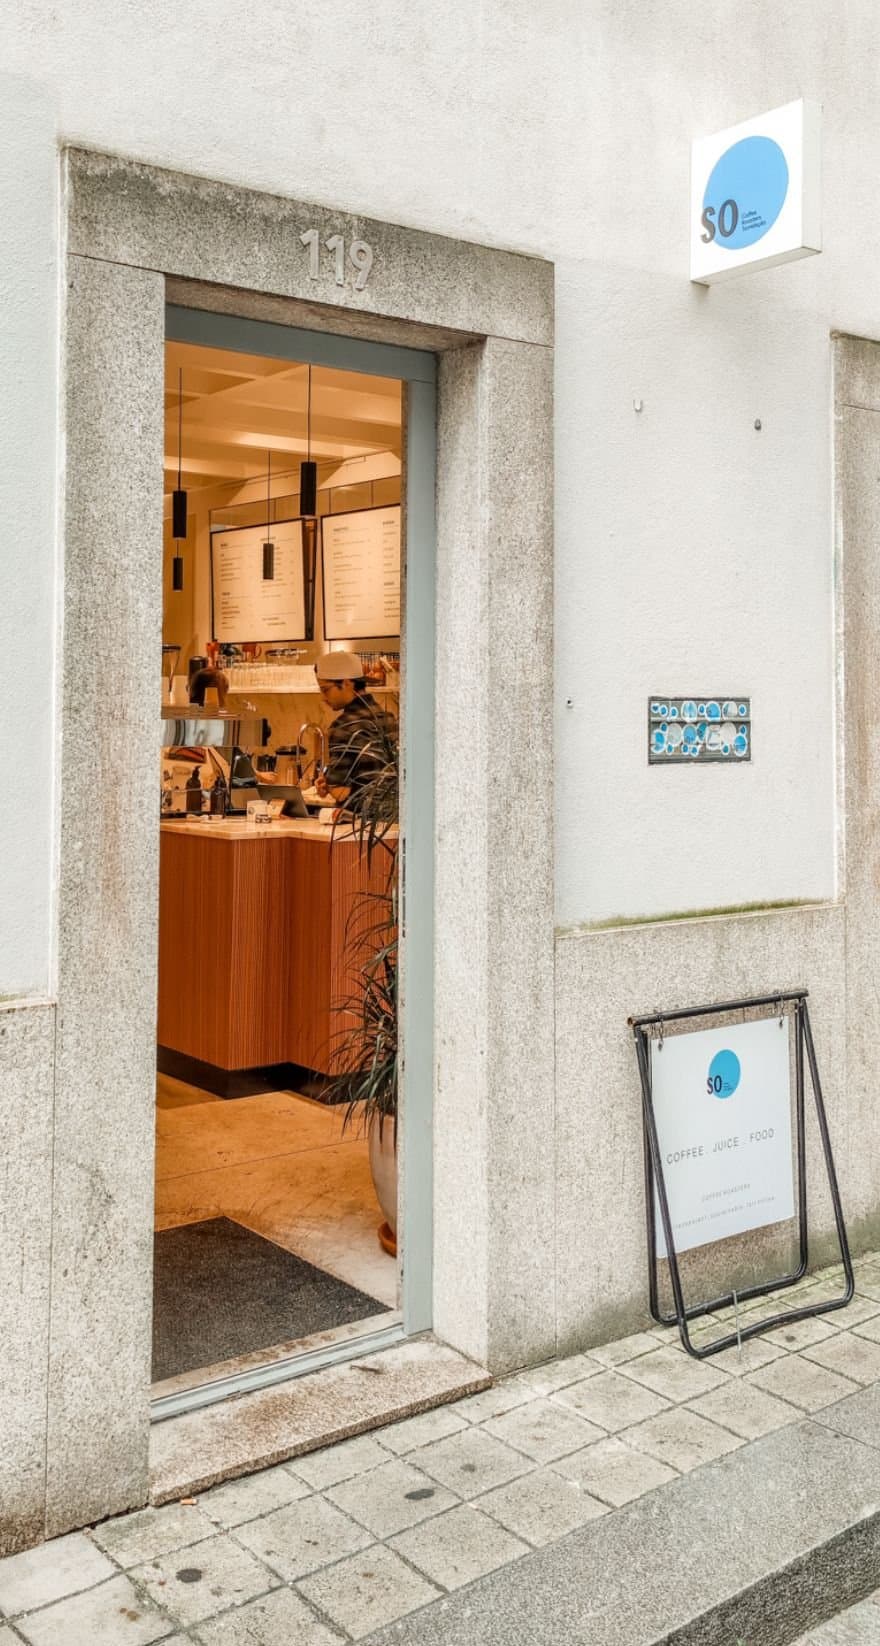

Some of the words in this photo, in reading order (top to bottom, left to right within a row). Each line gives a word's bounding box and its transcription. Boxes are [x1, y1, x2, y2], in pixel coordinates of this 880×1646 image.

[700, 199, 739, 244] SO
[299, 228, 374, 291] 119
[706, 1075, 723, 1096] SO
[666, 1145, 705, 1165] COFFEE
[712, 1136, 740, 1153] JUICE
[749, 1127, 774, 1142] FOOD
